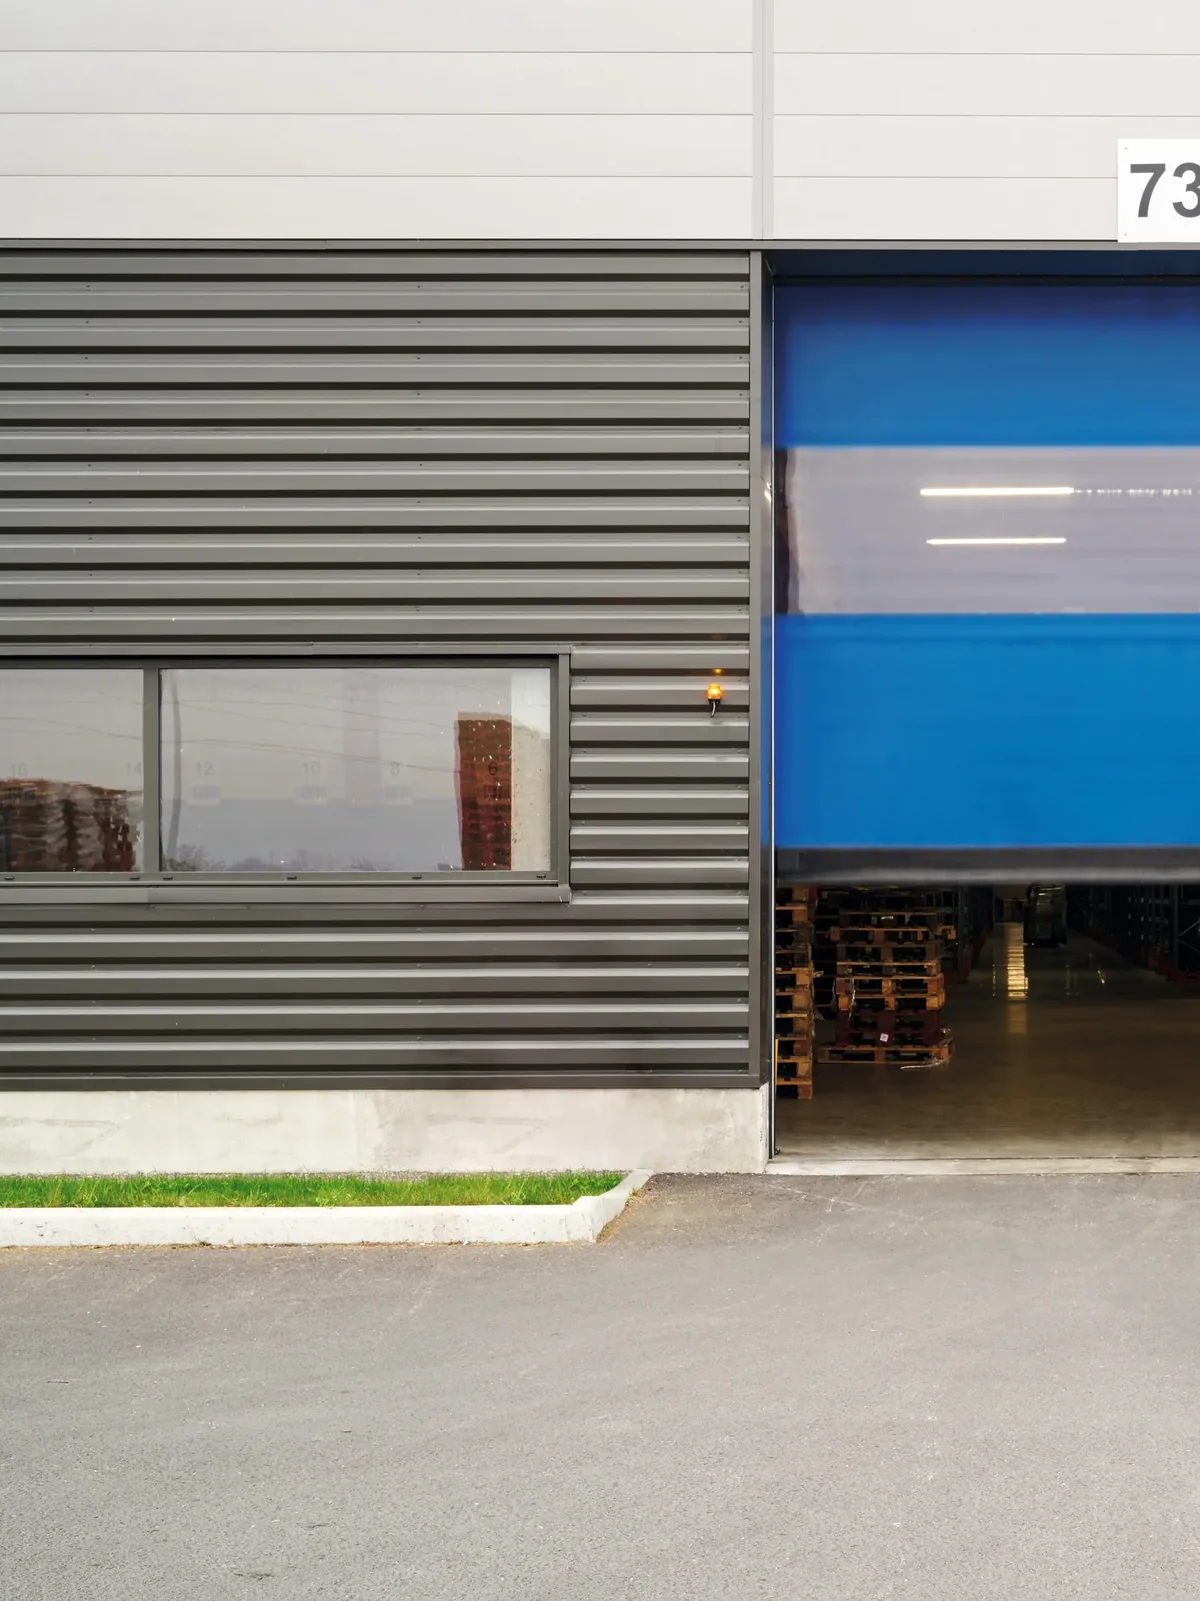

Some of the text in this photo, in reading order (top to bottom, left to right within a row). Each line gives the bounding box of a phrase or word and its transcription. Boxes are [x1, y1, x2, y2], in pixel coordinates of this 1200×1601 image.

[195, 761, 214, 776] 12
[301, 761, 322, 776] 10
[488, 761, 498, 776] 6
